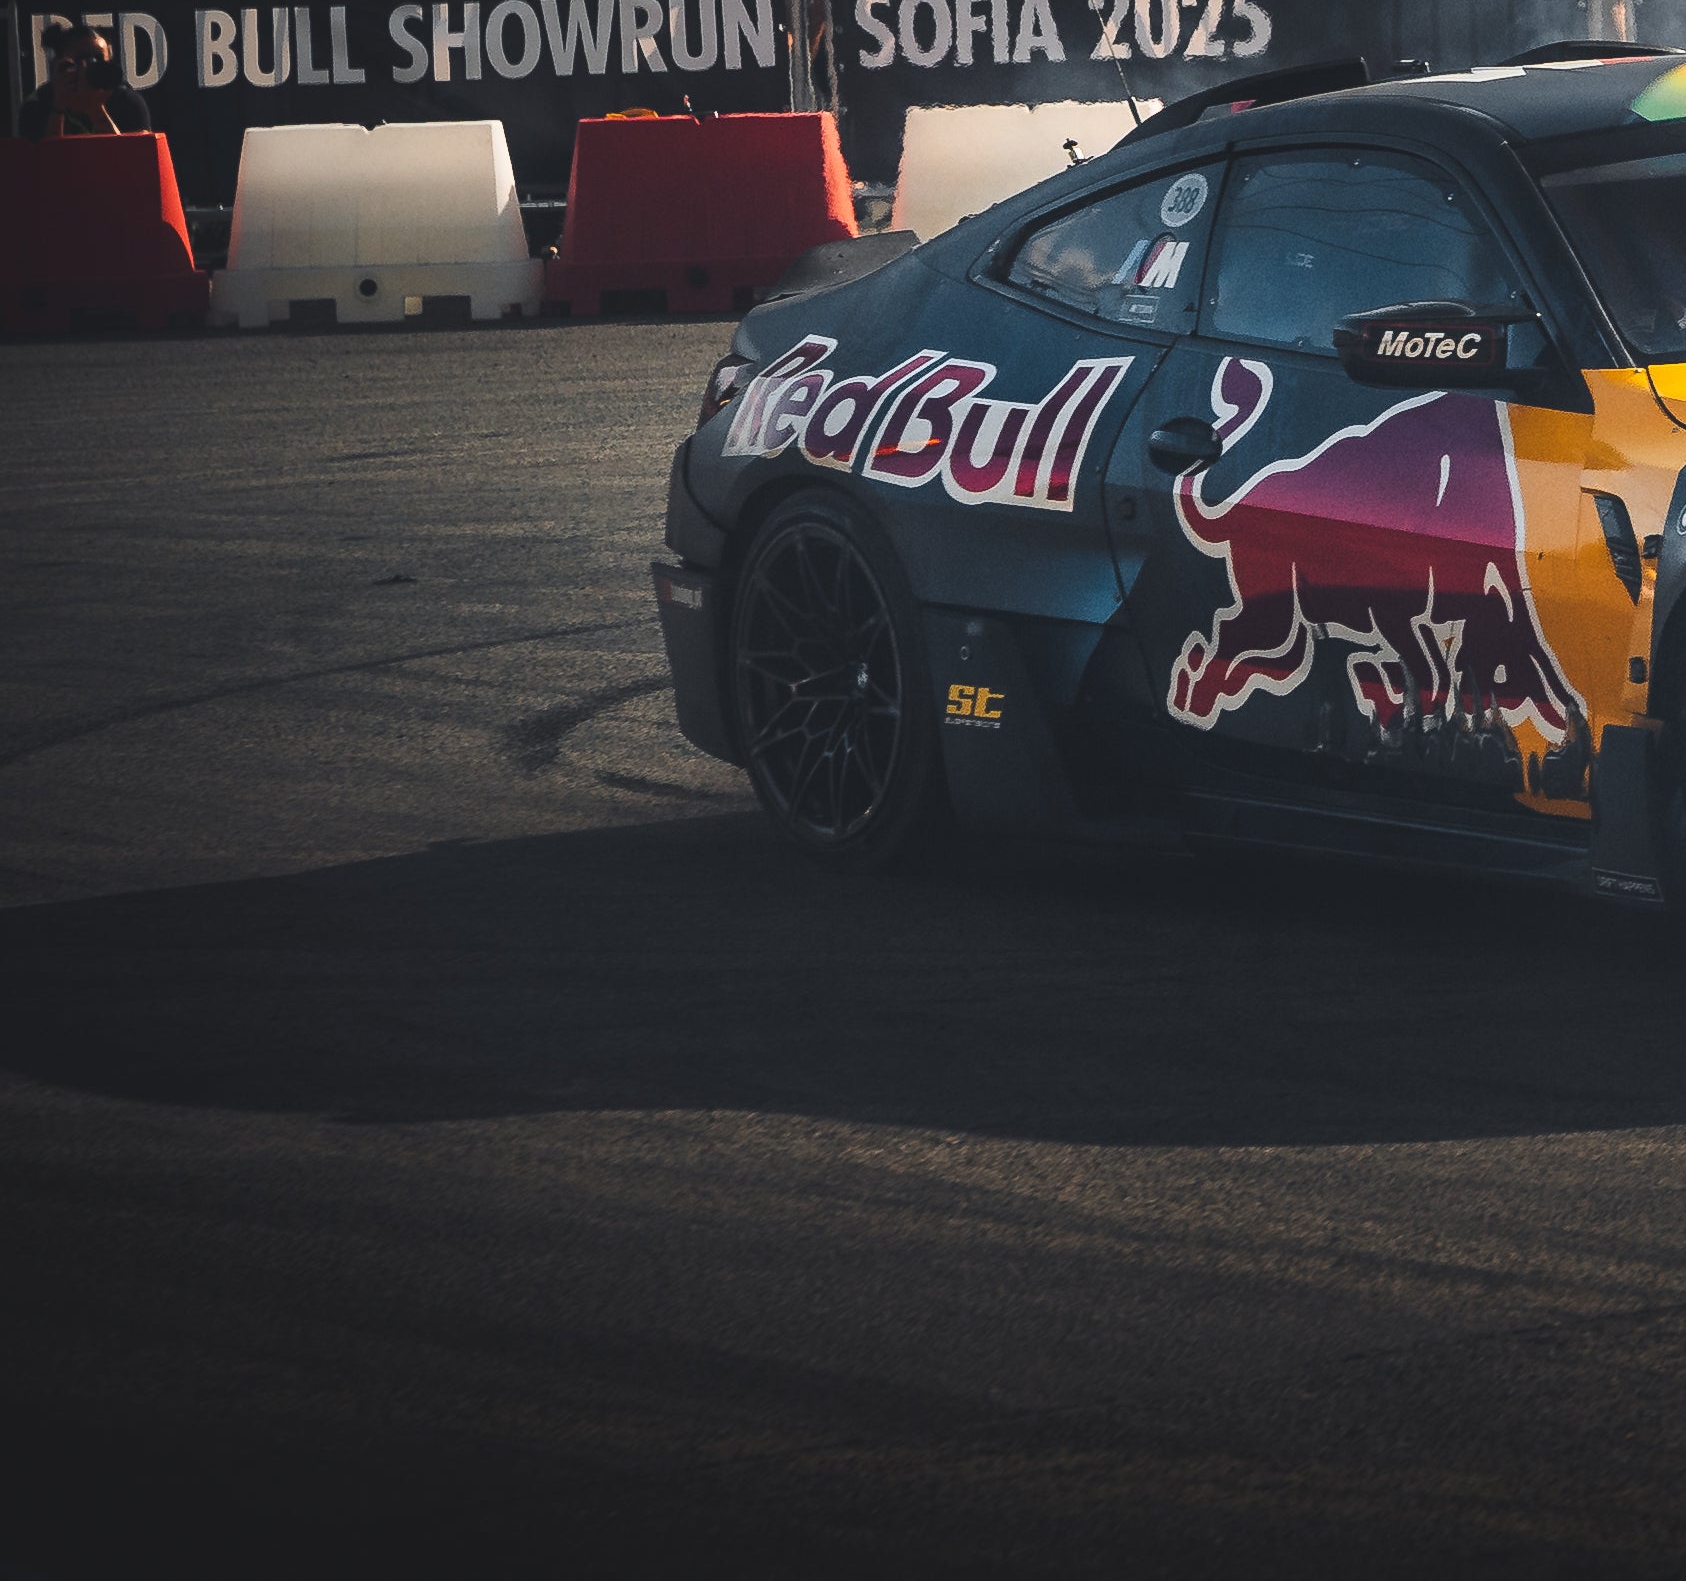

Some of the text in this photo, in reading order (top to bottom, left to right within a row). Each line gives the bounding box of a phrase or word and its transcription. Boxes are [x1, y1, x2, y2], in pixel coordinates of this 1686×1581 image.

[31, 11, 168, 91] RD
[195, 6, 366, 88] BULL
[1377, 330, 1482, 359] MoTeC
[721, 334, 1136, 512] Red Bull
